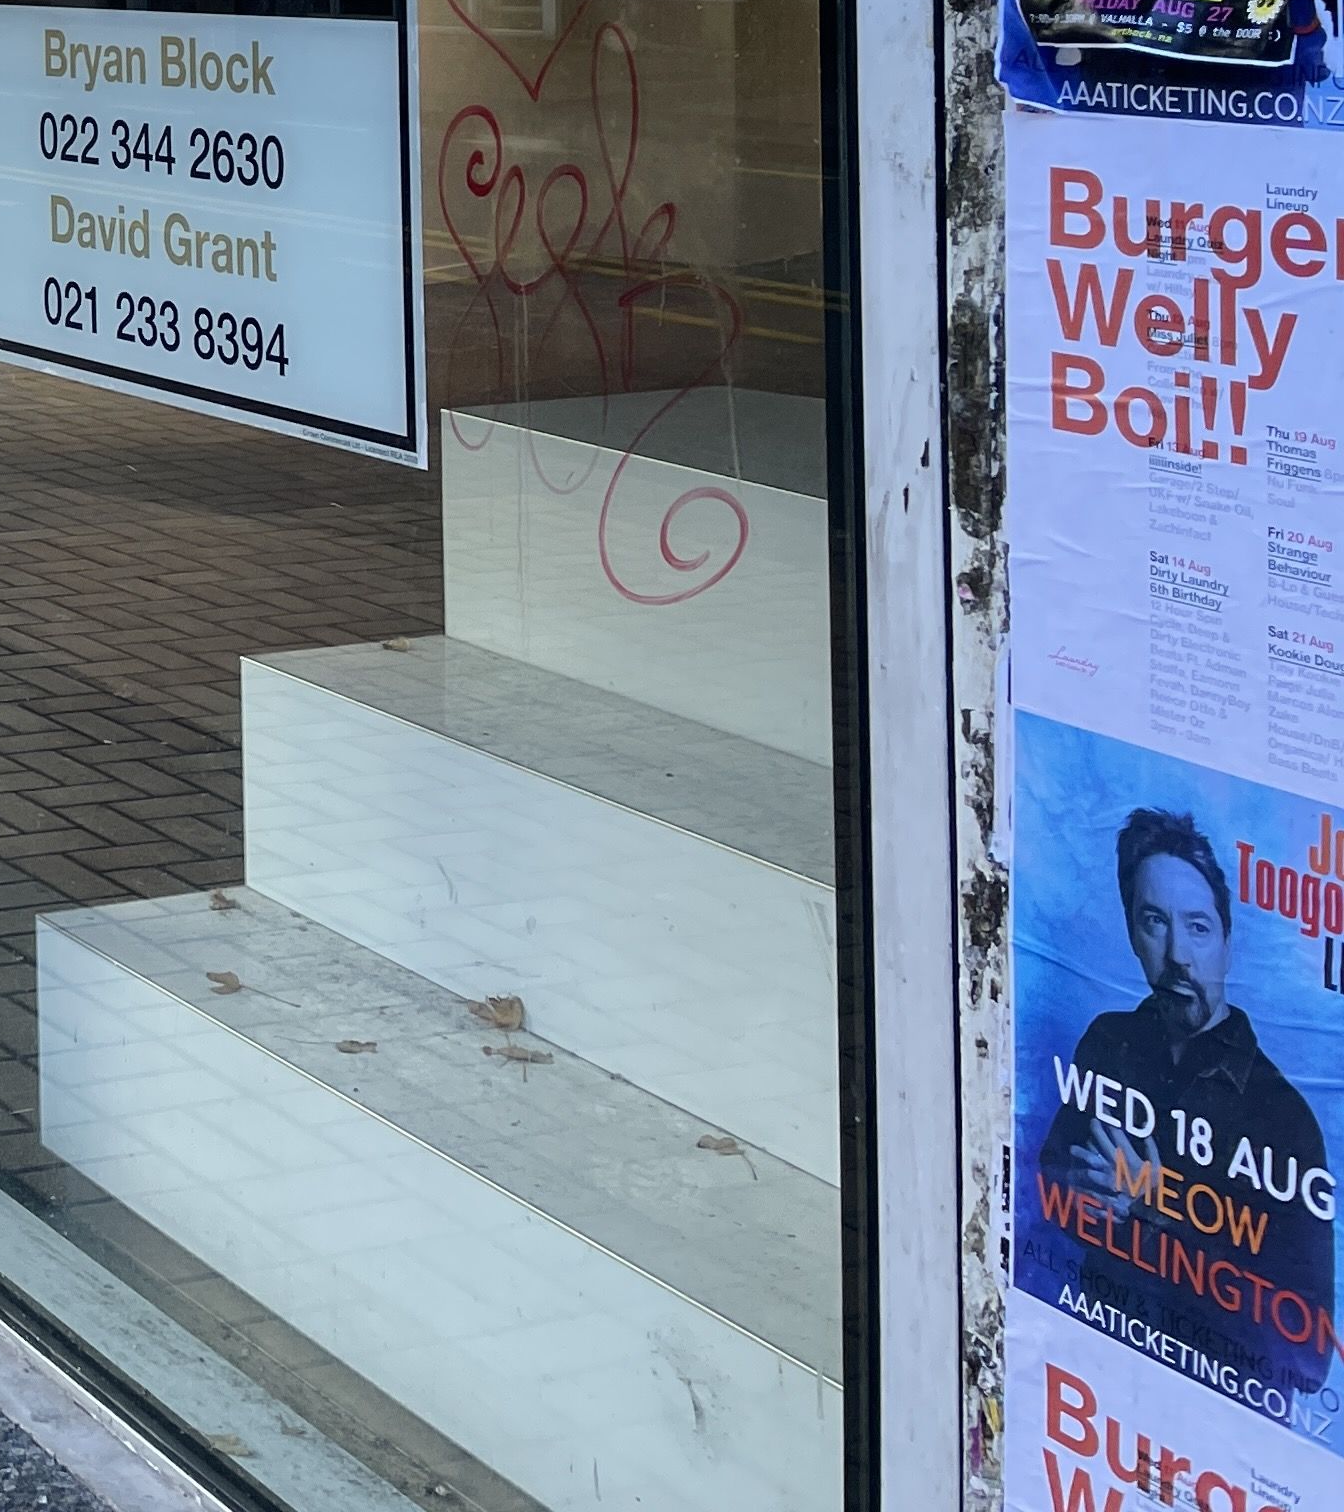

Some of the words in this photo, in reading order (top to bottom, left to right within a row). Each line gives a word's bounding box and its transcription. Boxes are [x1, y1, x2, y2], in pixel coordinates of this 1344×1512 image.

[1100, 13, 1154, 27] VALHALLA
[1176, 21, 1193, 35] $5
[1212, 27, 1232, 39] the
[1235, 28, 1262, 39] DOOR
[1206, 6, 1234, 22] 27
[43, 28, 147, 92] Bryan
[159, 35, 276, 96] Block
[1056, 79, 1344, 127] AAATICKETING.CO.NZ
[39, 111, 100, 166] 022
[111, 118, 177, 176] 344
[188, 127, 285, 190] 2630
[1266, 183, 1318, 201] Laundry
[1266, 197, 1310, 214] Lineup
[49, 194, 151, 260] David
[162, 212, 278, 282] Grant
[1049, 166, 1344, 289] Burge
[1146, 216, 1172, 229] Wed
[1188, 222, 1211, 235] Aug
[1146, 233, 1194, 248] Laundry
[1146, 247, 1177, 263] Night
[43, 276, 99, 335] 021
[115, 290, 181, 353] 233
[192, 305, 290, 377] 8394
[1046, 258, 1298, 391] Welly
[1146, 309, 1169, 323] Thu
[1146, 326, 1174, 341] Miss
[1050, 351, 1248, 466] Boi!!
[1148, 437, 1164, 450] Fri
[1266, 424, 1290, 440] Thu
[1294, 431, 1307, 443] 19
[1310, 433, 1337, 450] Aug
[1266, 439, 1317, 459] Thomas
[1267, 456, 1323, 479] Friggens
[1267, 526, 1285, 540] Fri
[1287, 530, 1304, 544] 20
[1308, 535, 1334, 553] Aug
[1267, 541, 1319, 564] Strange
[1149, 550, 1170, 566] Sat
[1172, 556, 1185, 568] 14
[1188, 560, 1212, 577] Aug
[1267, 558, 1332, 583] Behaviour
[1149, 564, 1179, 584] Dirty
[1180, 572, 1230, 596] Laundry
[1149, 582, 1170, 596] 6th
[1172, 586, 1223, 612] Birthday
[1267, 625, 1289, 641] Sat
[1291, 631, 1306, 645] 21
[1309, 635, 1335, 654] Aug
[1267, 642, 1311, 664] Kookie
[1053, 1055, 1156, 1139] WED
[1170, 1109, 1214, 1167] 18
[1227, 1136, 1337, 1222] AUG
[1115, 1147, 1269, 1256] MEOW
[1023, 1239, 1059, 1275] ALL
[1065, 1258, 1130, 1307] SHOW
[1036, 1172, 1344, 1365] WELLINGTON
[1058, 1283, 1334, 1445] AAATICKETING.CO.NZ
